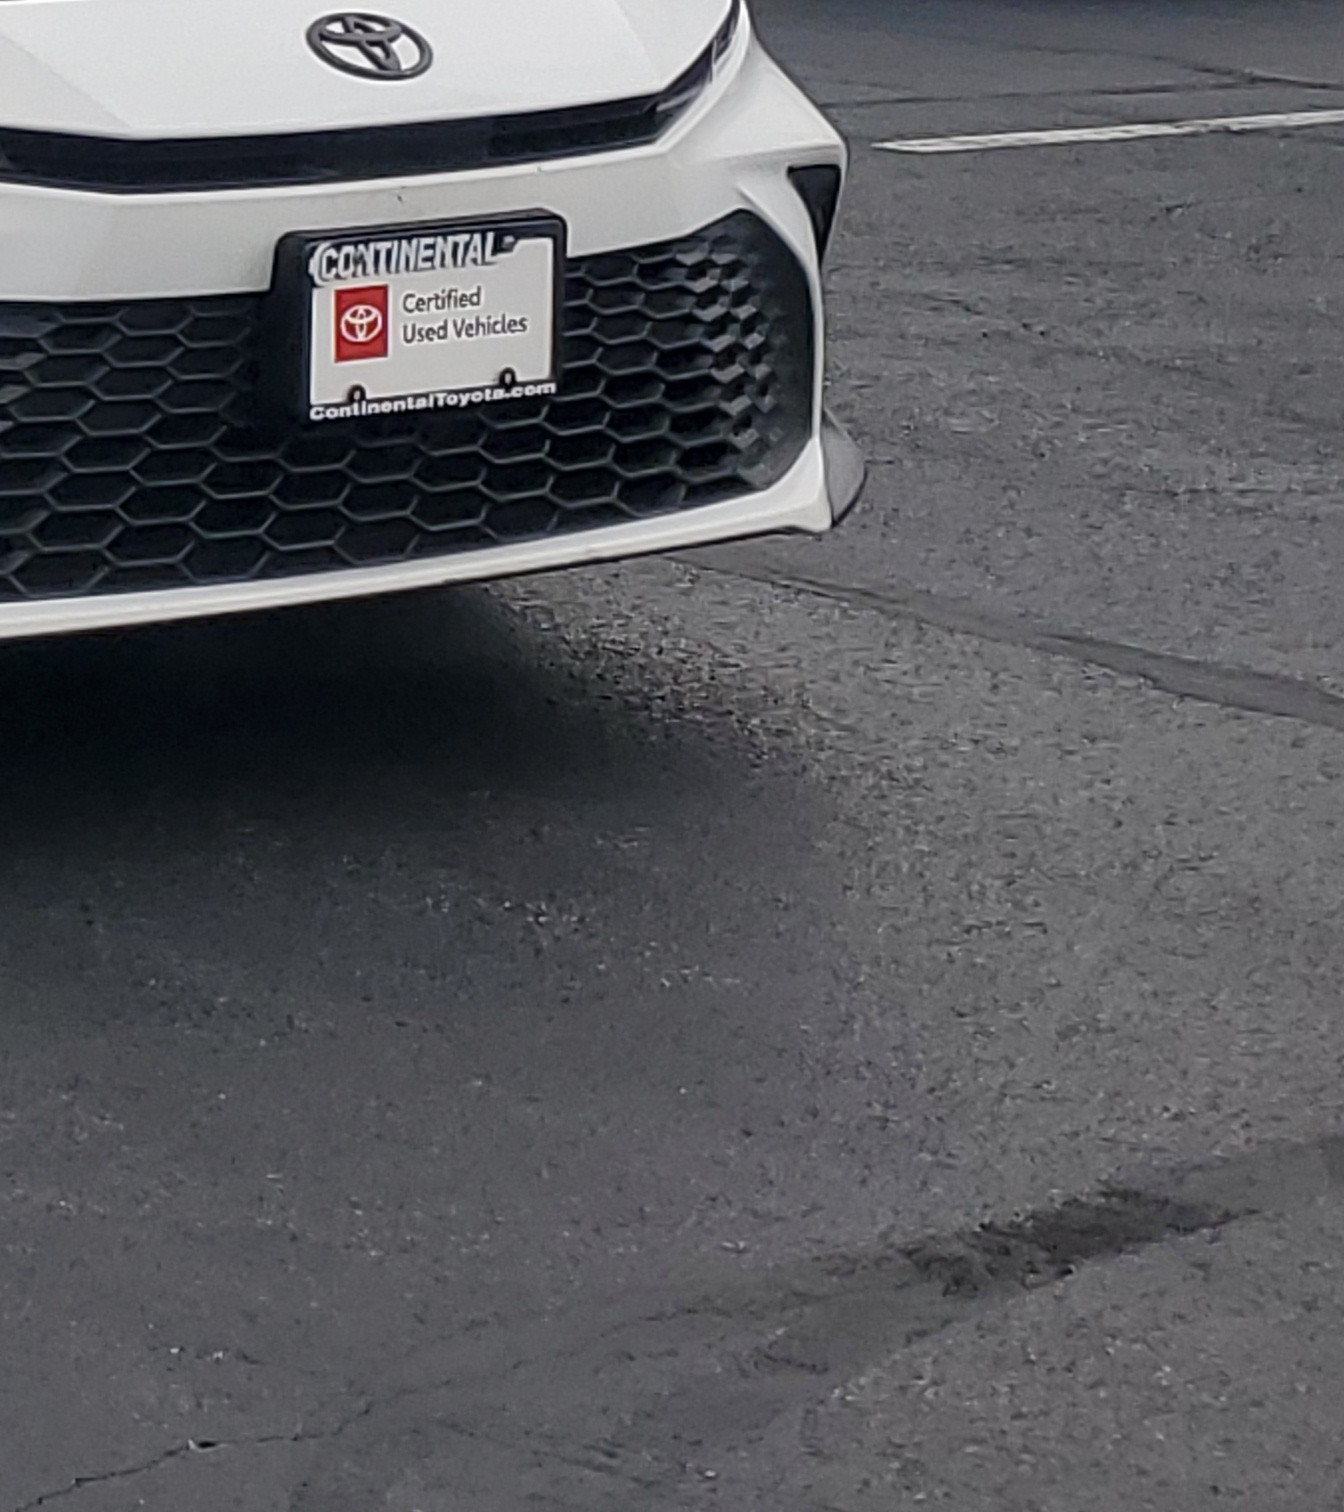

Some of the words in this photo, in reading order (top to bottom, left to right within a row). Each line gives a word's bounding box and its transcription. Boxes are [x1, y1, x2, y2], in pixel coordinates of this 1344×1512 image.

[319, 232, 496, 281] CONTINENTAL
[402, 286, 481, 313] Certified
[402, 322, 448, 344] Used
[453, 314, 528, 338] Vehicles
[310, 382, 557, 420] ContinentalToyota.com
